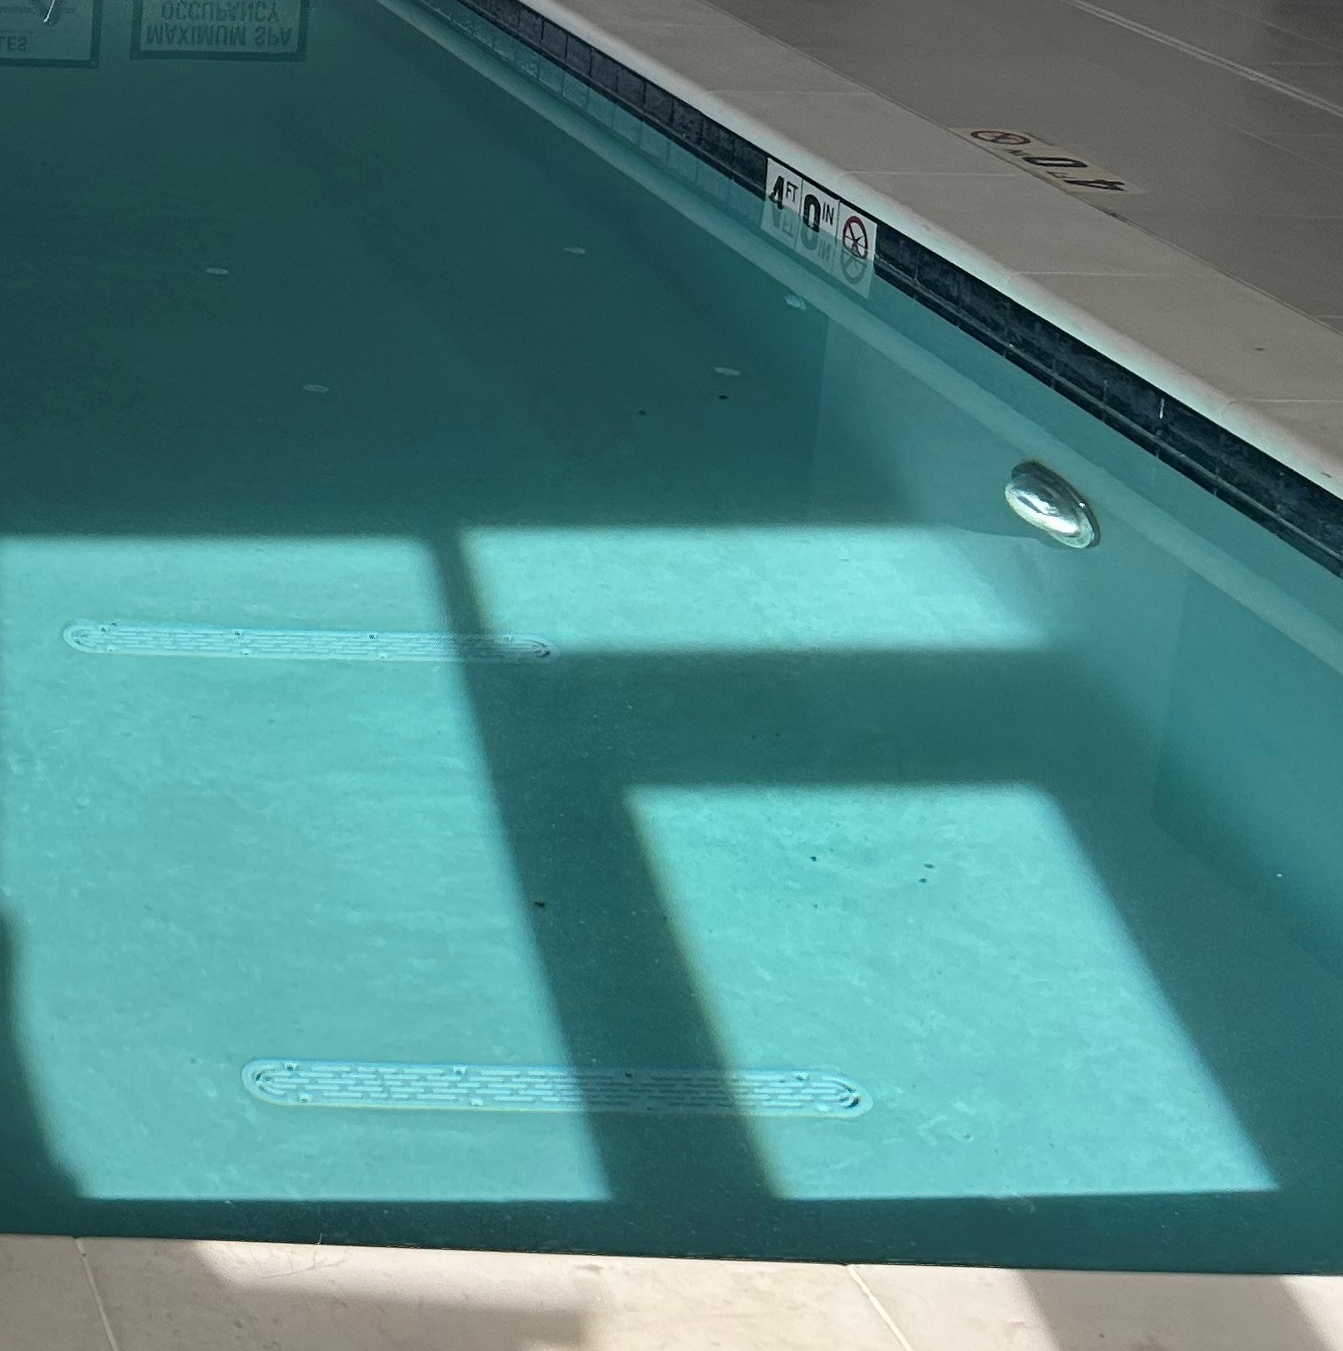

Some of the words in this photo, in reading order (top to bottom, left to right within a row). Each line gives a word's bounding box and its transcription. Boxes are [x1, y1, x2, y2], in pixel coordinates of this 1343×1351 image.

[769, 176, 785, 209] 4
[786, 181, 798, 203] FT
[822, 202, 834, 225] IN
